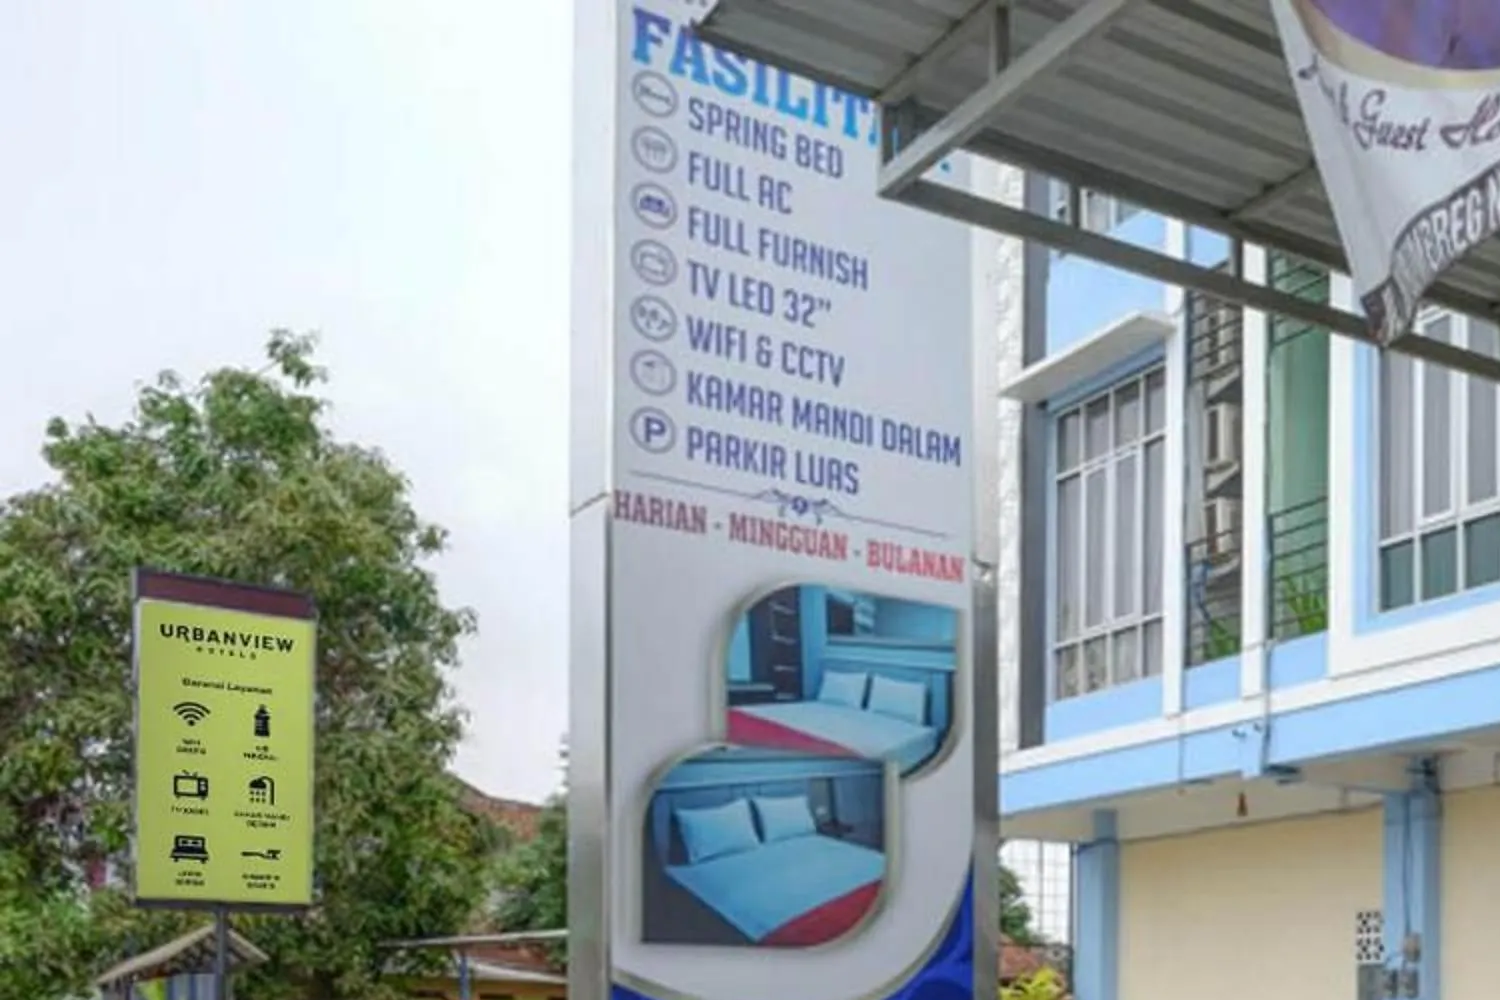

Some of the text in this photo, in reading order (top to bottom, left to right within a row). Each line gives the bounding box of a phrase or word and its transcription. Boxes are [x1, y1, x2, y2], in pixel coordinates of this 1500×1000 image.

[632, 8, 949, 172] FASILIT
[1353, 89, 1430, 150] Guest
[688, 97, 843, 179] SPRING BED
[688, 151, 793, 215] FULL AC
[688, 207, 869, 291] FULL FURNISH
[687, 260, 720, 300] TV
[729, 270, 774, 317] LED
[686, 315, 846, 387] WIFI & CCTV
[687, 371, 962, 466] KAMAR MANDI DALAM
[687, 426, 787, 480] PARKIR
[795, 450, 860, 496] LUAS
[614, 489, 707, 534] HARIAN
[729, 511, 848, 561] MINGGUAN
[866, 538, 965, 583] BULANAN
[160, 624, 294, 653] URBANVIEW
